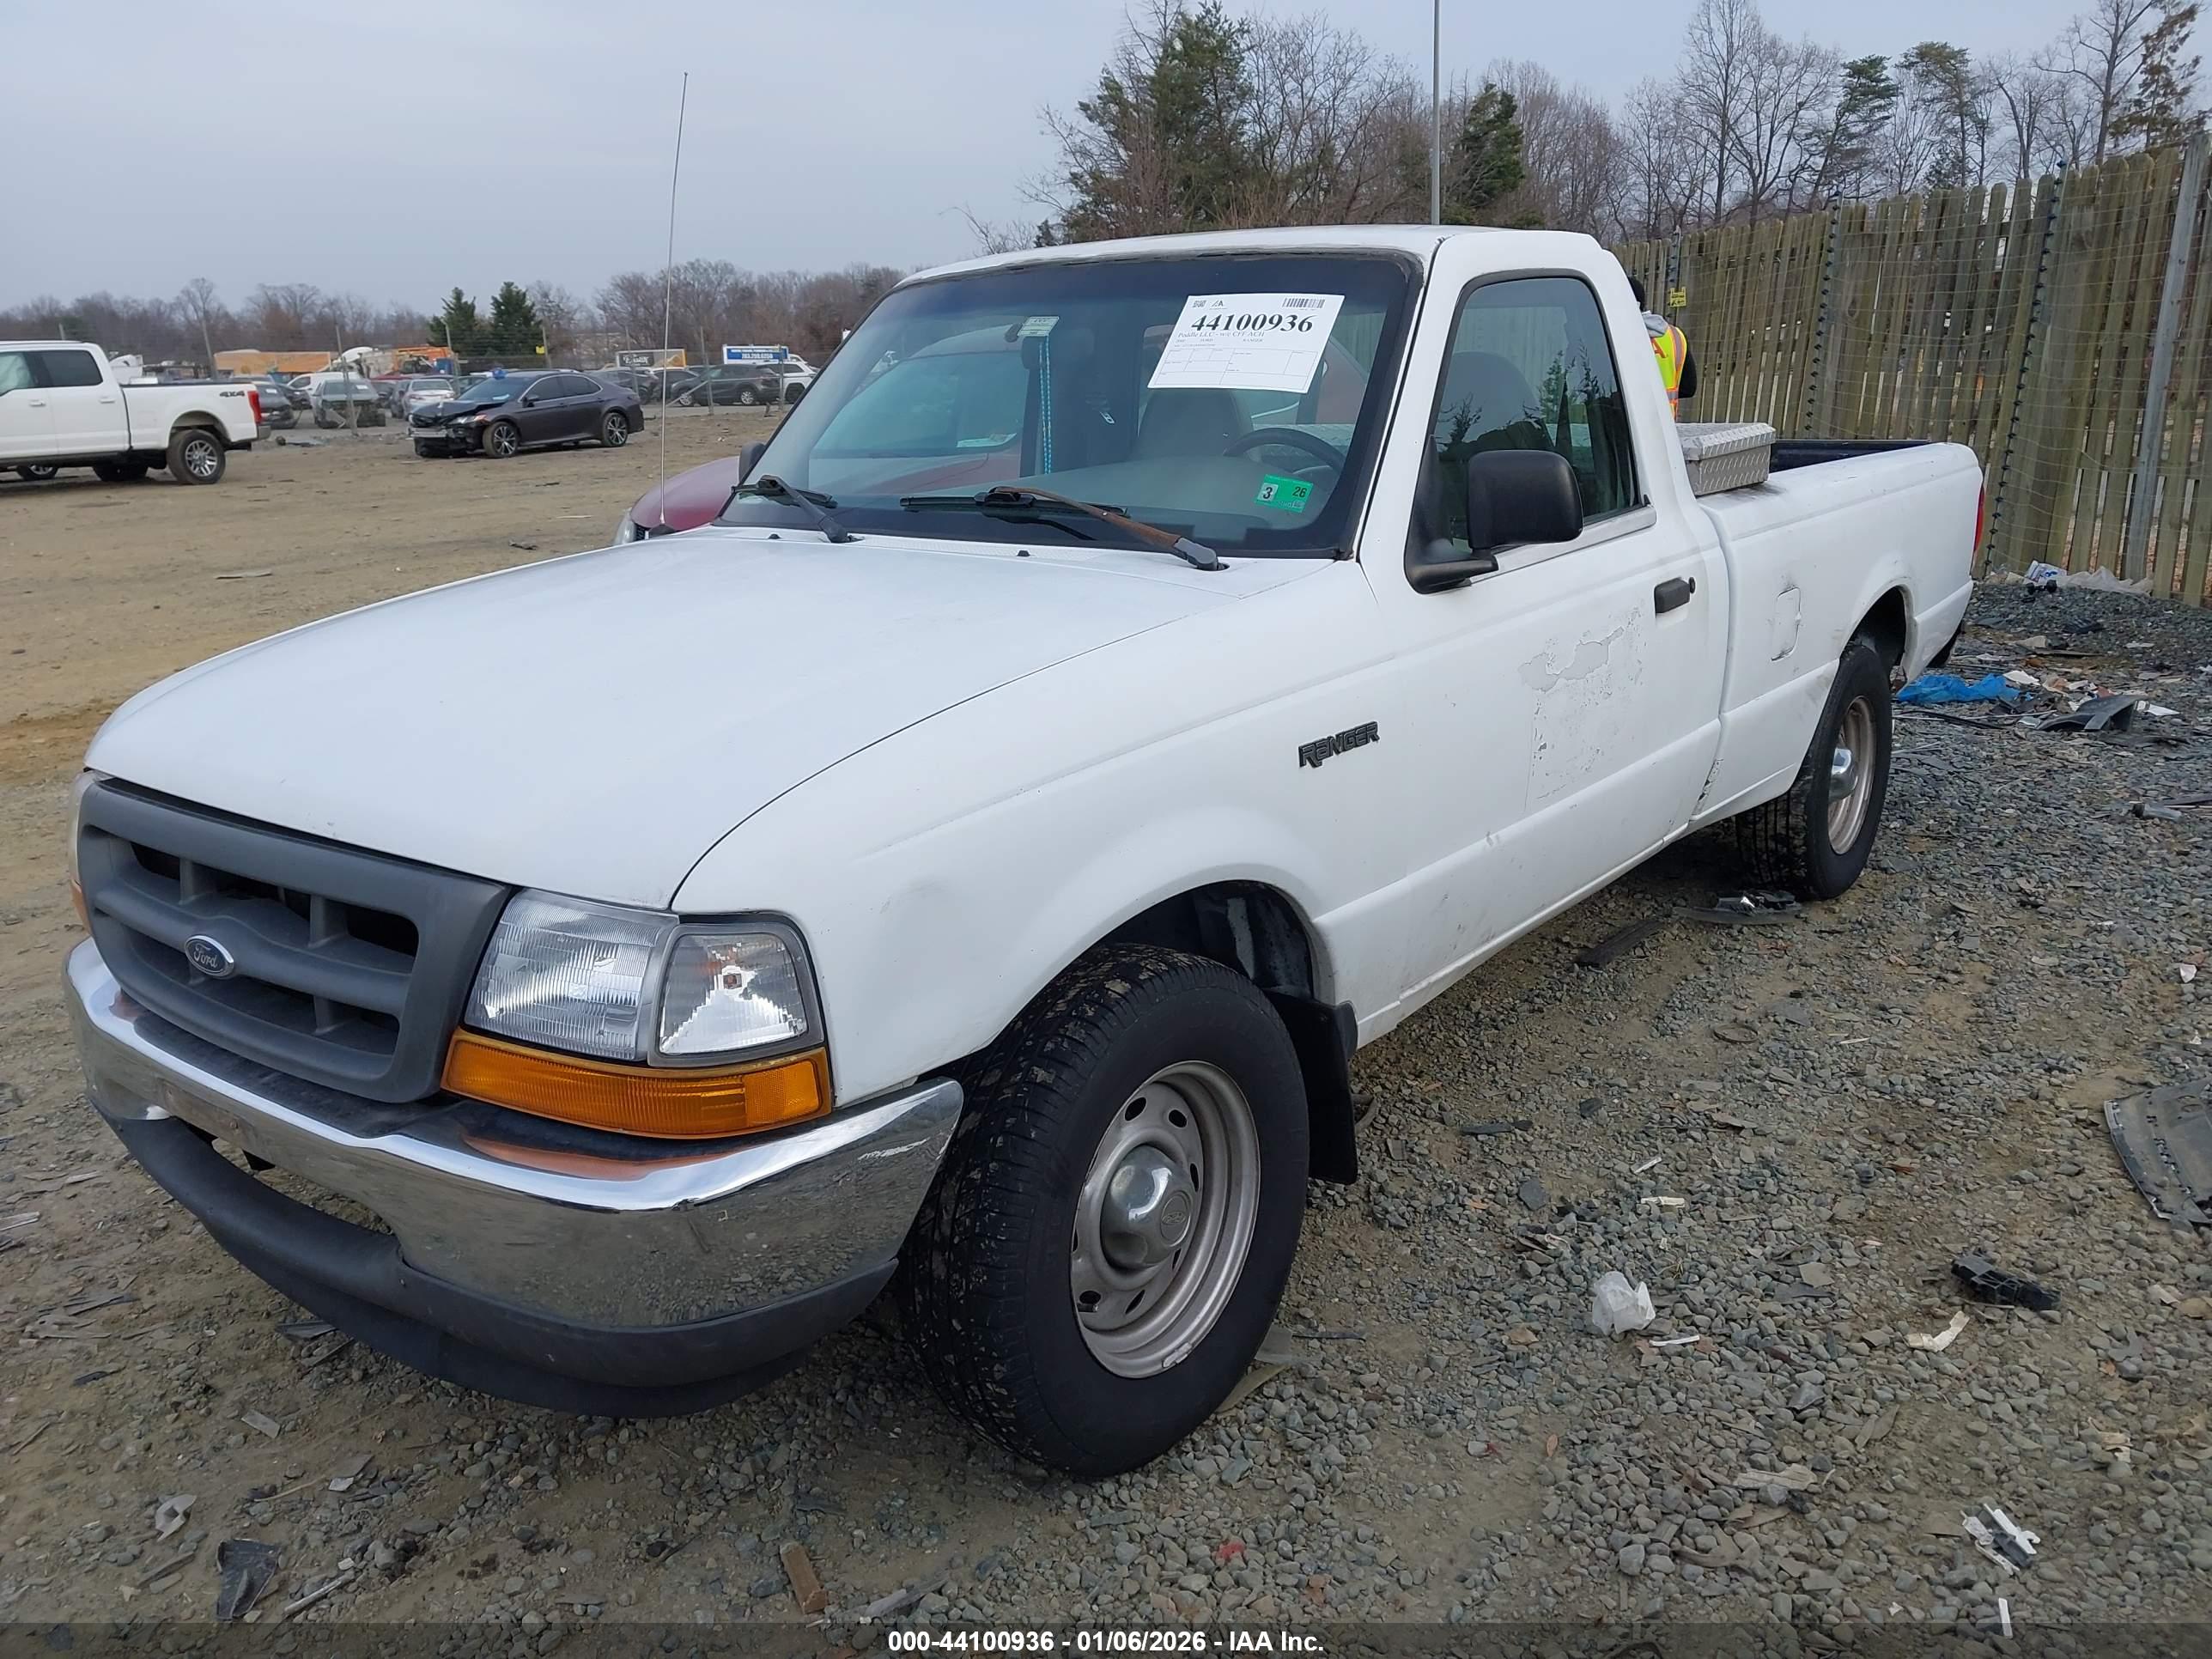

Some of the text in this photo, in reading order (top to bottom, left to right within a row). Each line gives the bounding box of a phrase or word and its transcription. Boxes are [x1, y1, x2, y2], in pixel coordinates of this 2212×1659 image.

[1190, 313, 1317, 333] 44100936
[1262, 486, 1308, 500] 3 26
[193, 943, 218, 969] Ford
